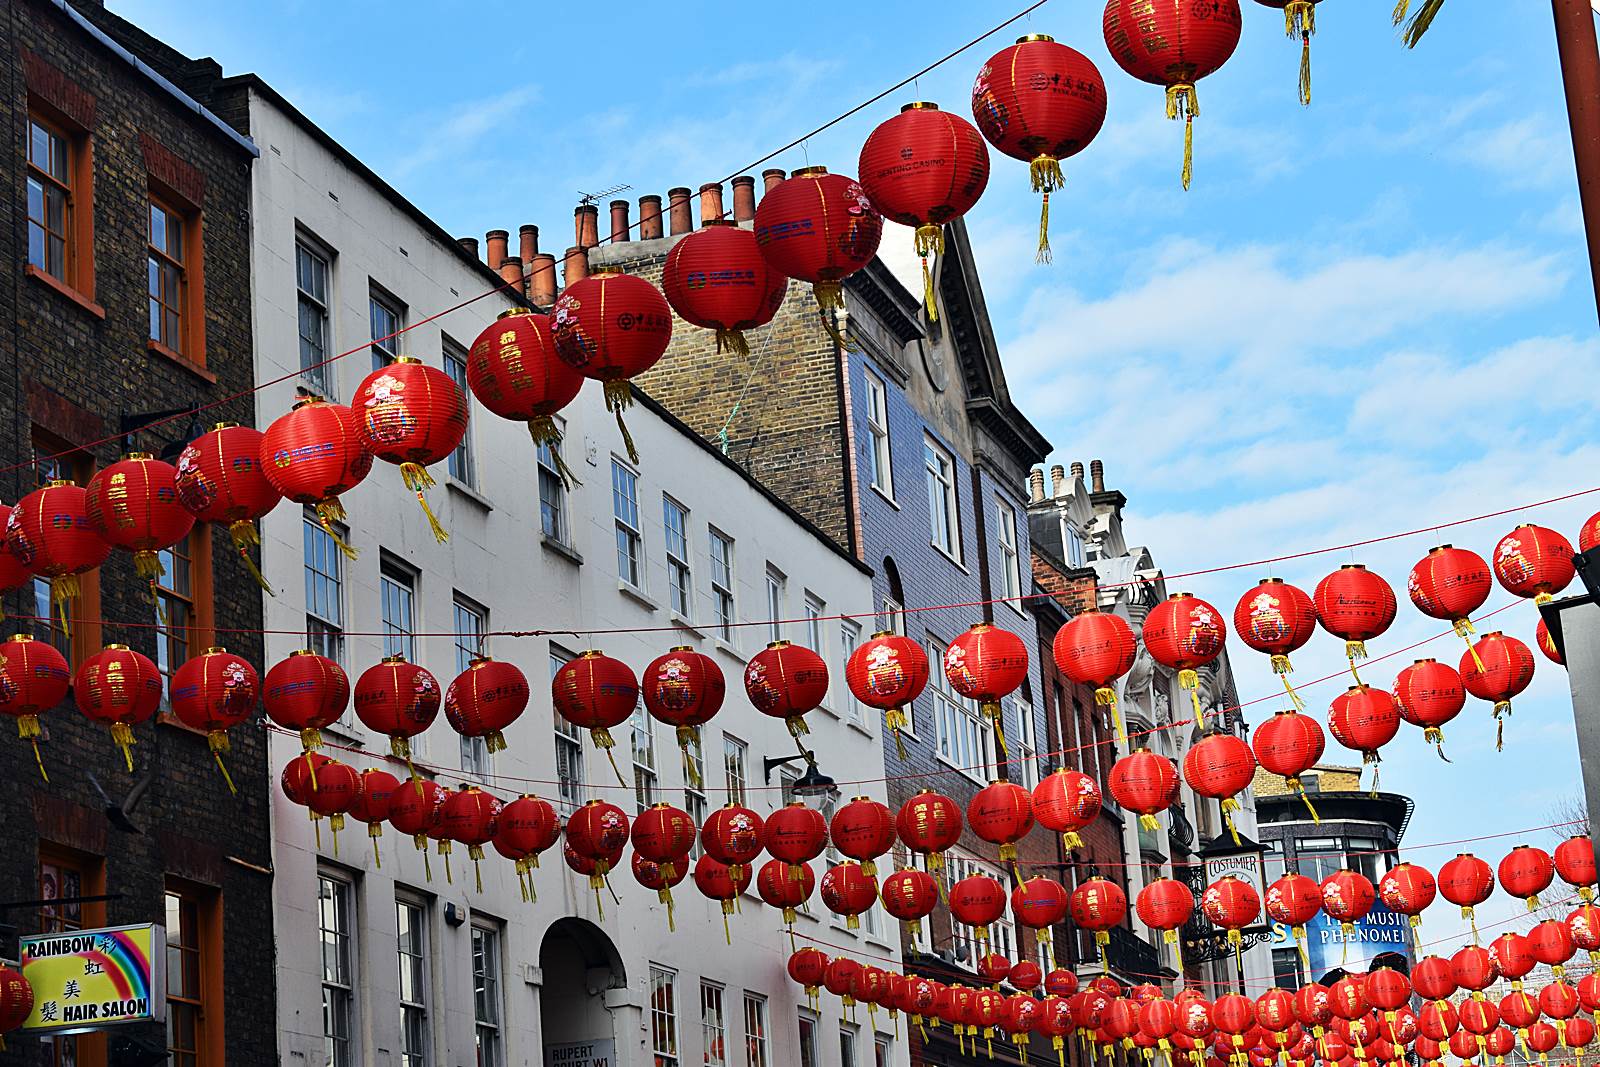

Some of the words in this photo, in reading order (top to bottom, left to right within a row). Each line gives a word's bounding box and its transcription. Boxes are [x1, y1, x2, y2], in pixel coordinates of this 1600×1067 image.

[1209, 856, 1257, 878] COSTUMIER
[27, 935, 96, 958] RAINBOW
[63, 1004, 98, 1022] HAIR
[101, 998, 147, 1018] SALON
[552, 1045, 594, 1061] RUPERT
